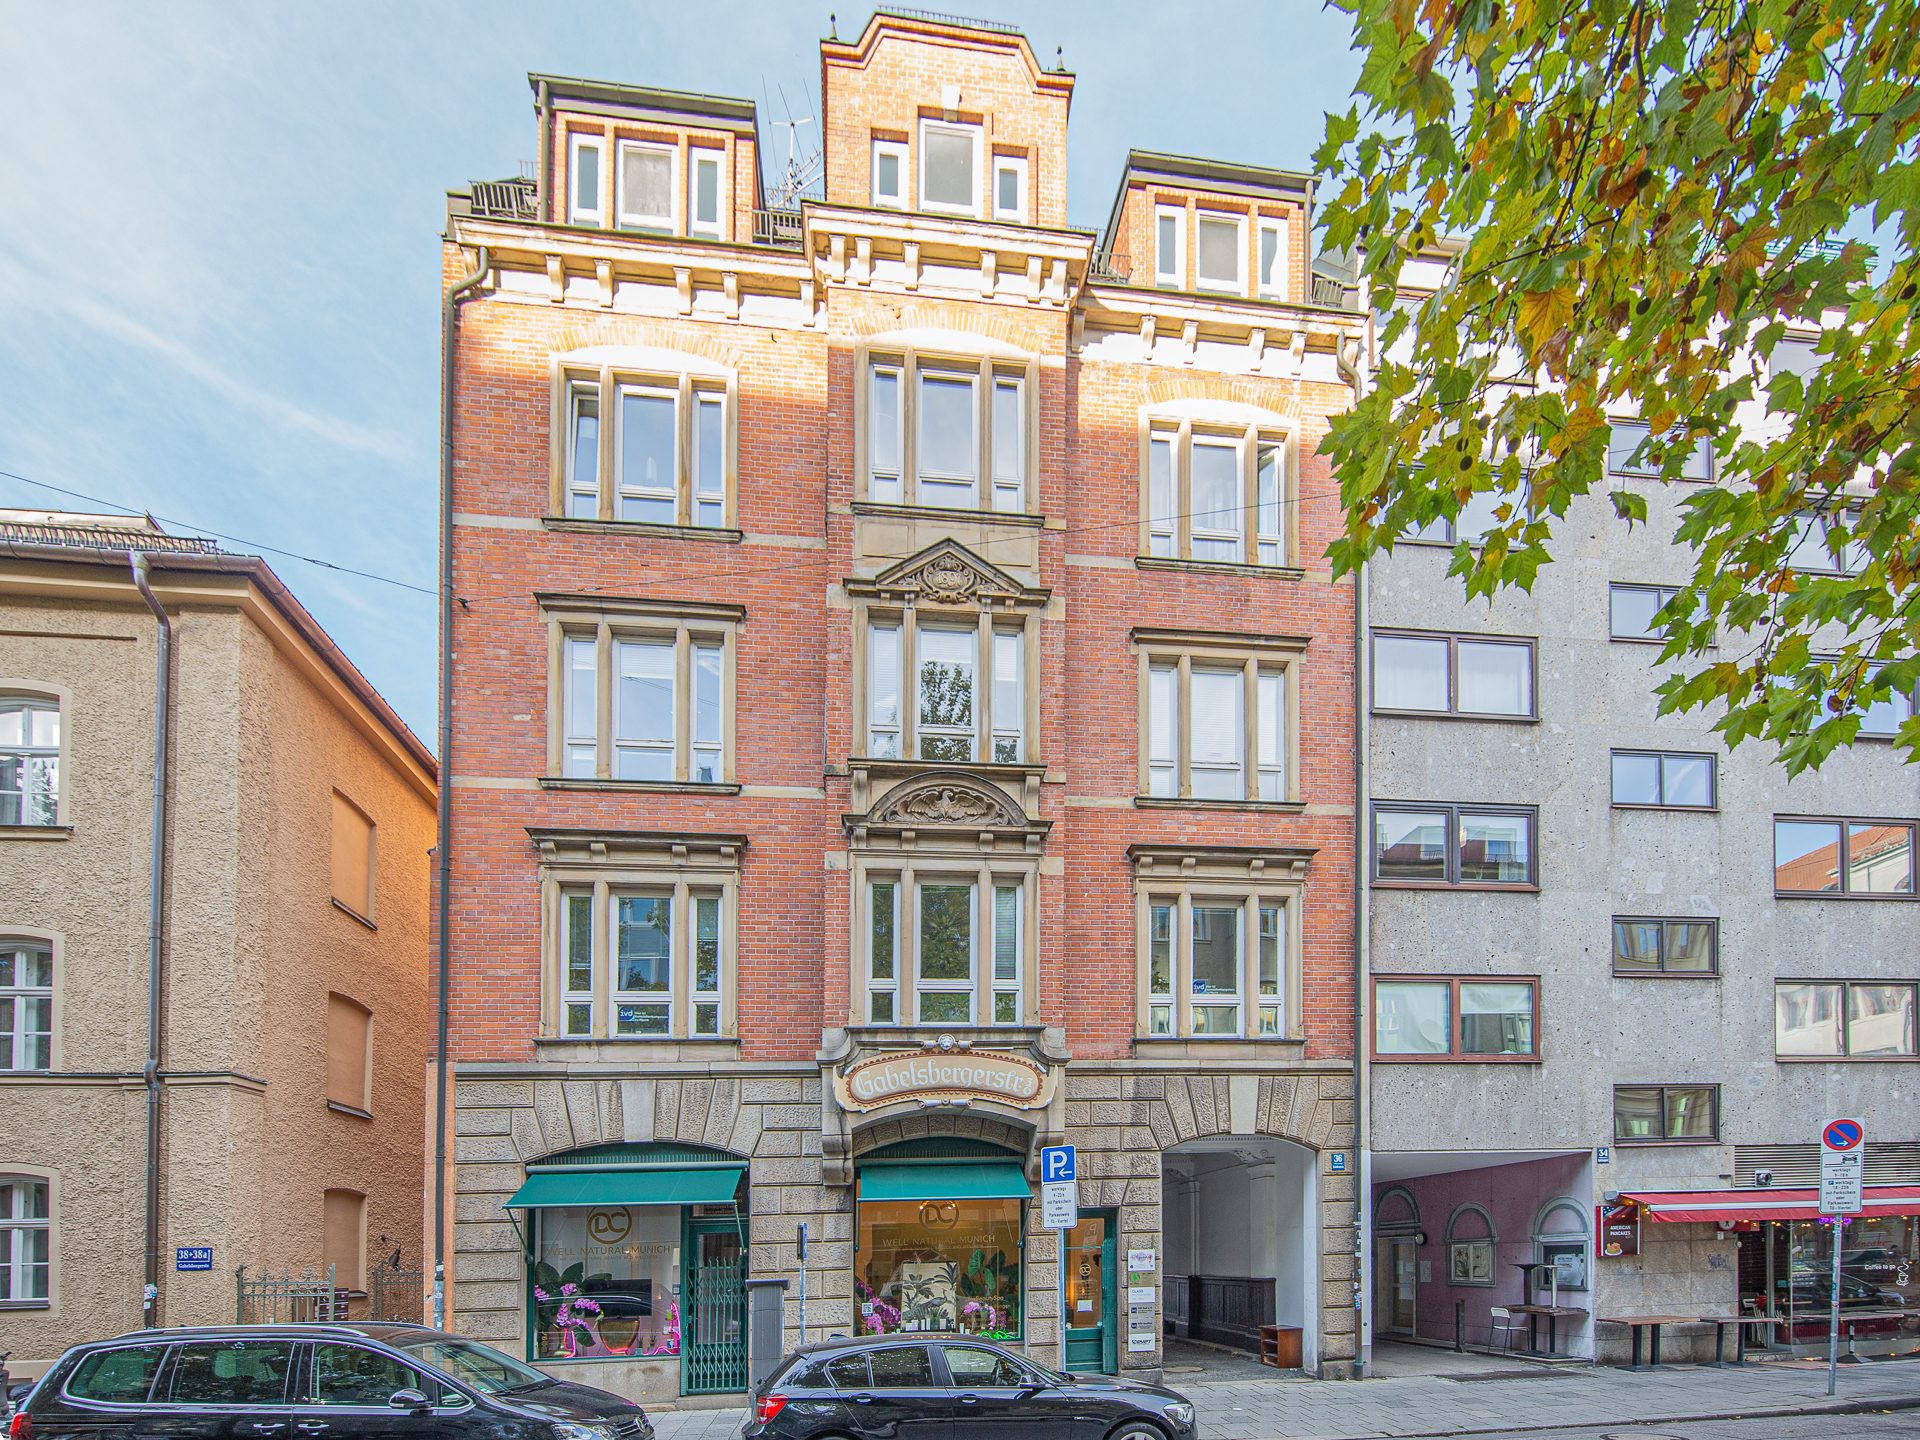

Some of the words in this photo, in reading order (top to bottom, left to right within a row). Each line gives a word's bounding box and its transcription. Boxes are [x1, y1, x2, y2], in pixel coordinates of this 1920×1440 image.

[620, 1009, 634, 1017] ivd
[854, 1058, 1024, 1097] Gabelsbergerstr.
[1333, 1154, 1343, 1163] 36
[1598, 1149, 1608, 1157] 34
[1049, 1151, 1068, 1179] P
[882, 1238, 908, 1247] WELL
[912, 1237, 955, 1245] NATURAL
[959, 1234, 996, 1243] MUNICH
[547, 1248, 576, 1257] WELL
[580, 1246, 630, 1255] NATURAL
[631, 1245, 671, 1254] MUNICH
